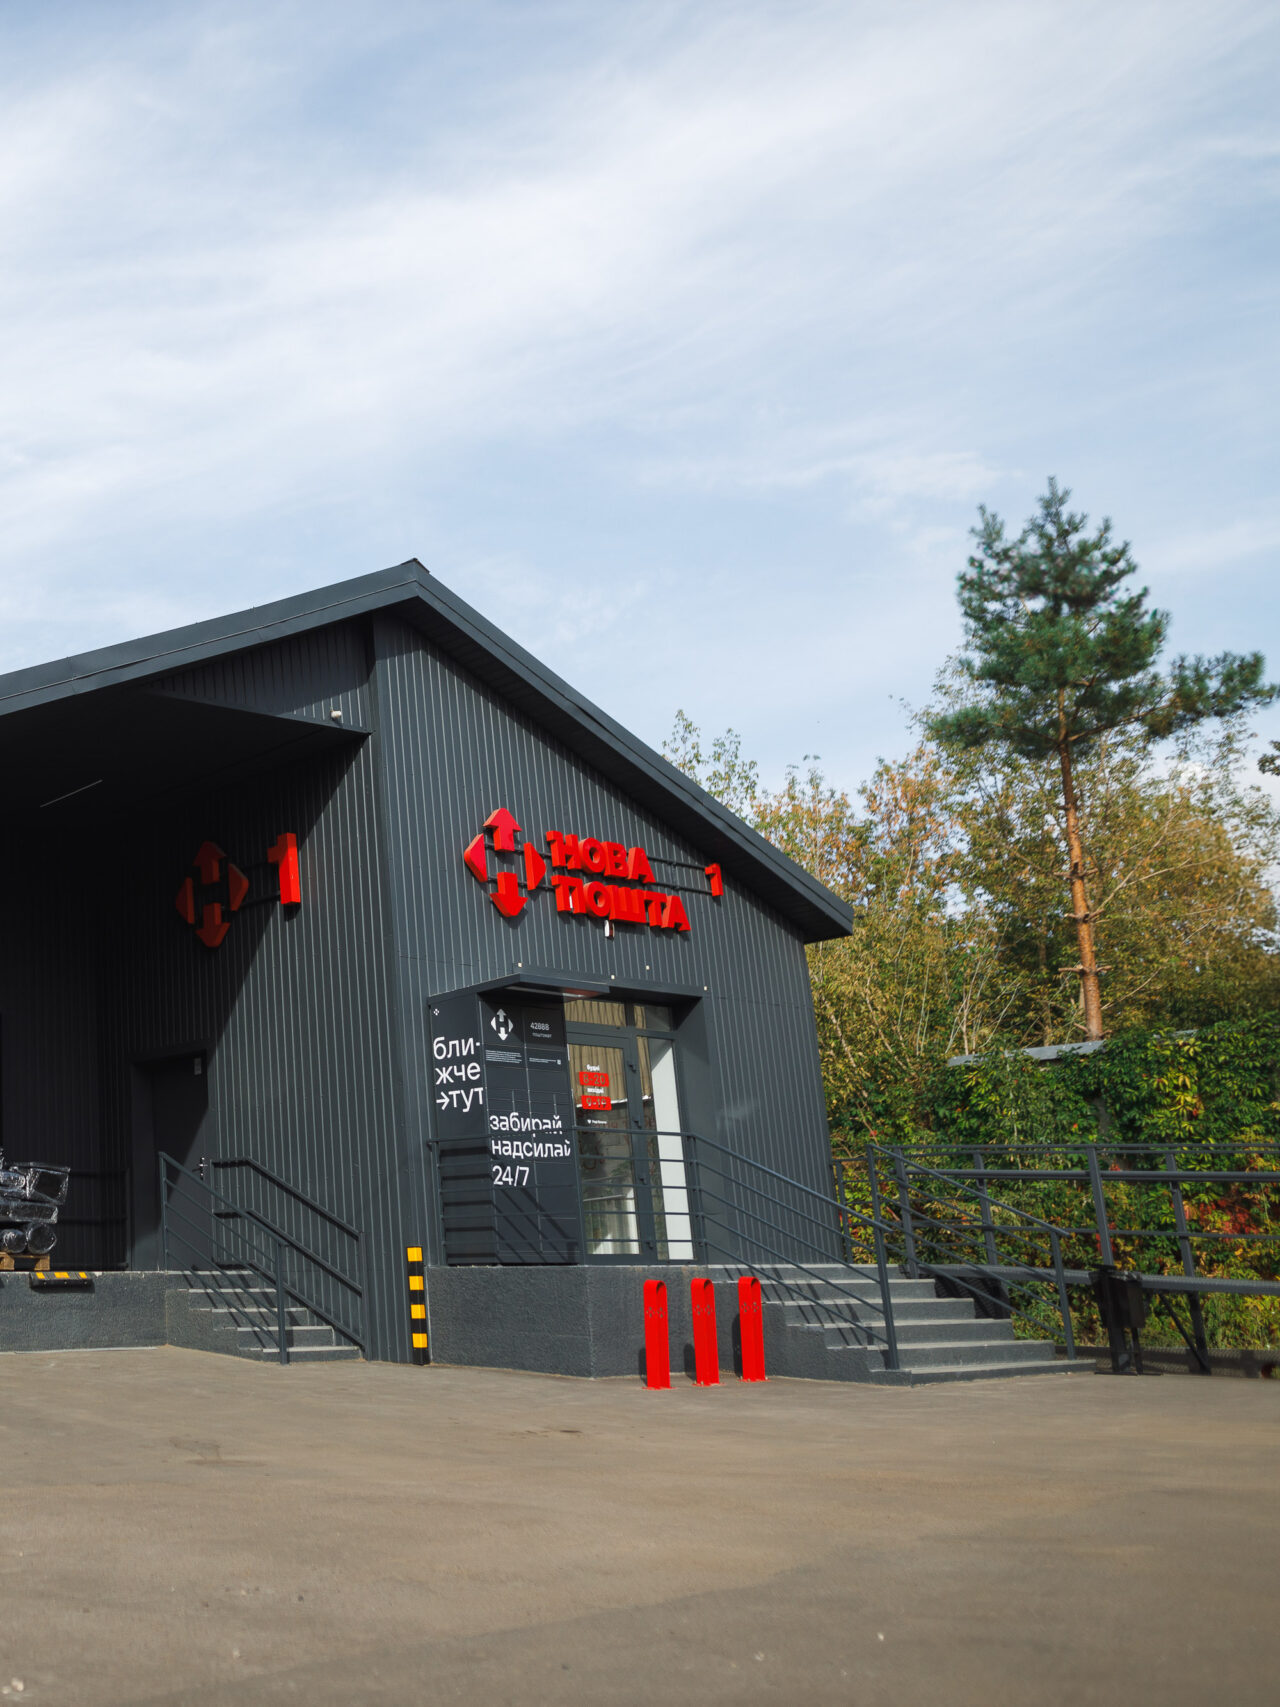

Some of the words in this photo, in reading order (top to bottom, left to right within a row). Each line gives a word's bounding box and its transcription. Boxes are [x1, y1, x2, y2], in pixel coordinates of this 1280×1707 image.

[267, 832, 301, 905] 1
[546, 830, 656, 883] НОВА
[705, 863, 724, 897] 1
[551, 875, 691, 931] ПОШТА
[433, 1036, 480, 1060] бли-
[435, 1062, 481, 1085] жче
[583, 1073, 606, 1085] 8-20
[448, 1087, 484, 1113] тут
[489, 1112, 563, 1137] забирай
[491, 1139, 571, 1159] надсилай
[492, 1165, 530, 1187] 24/7
